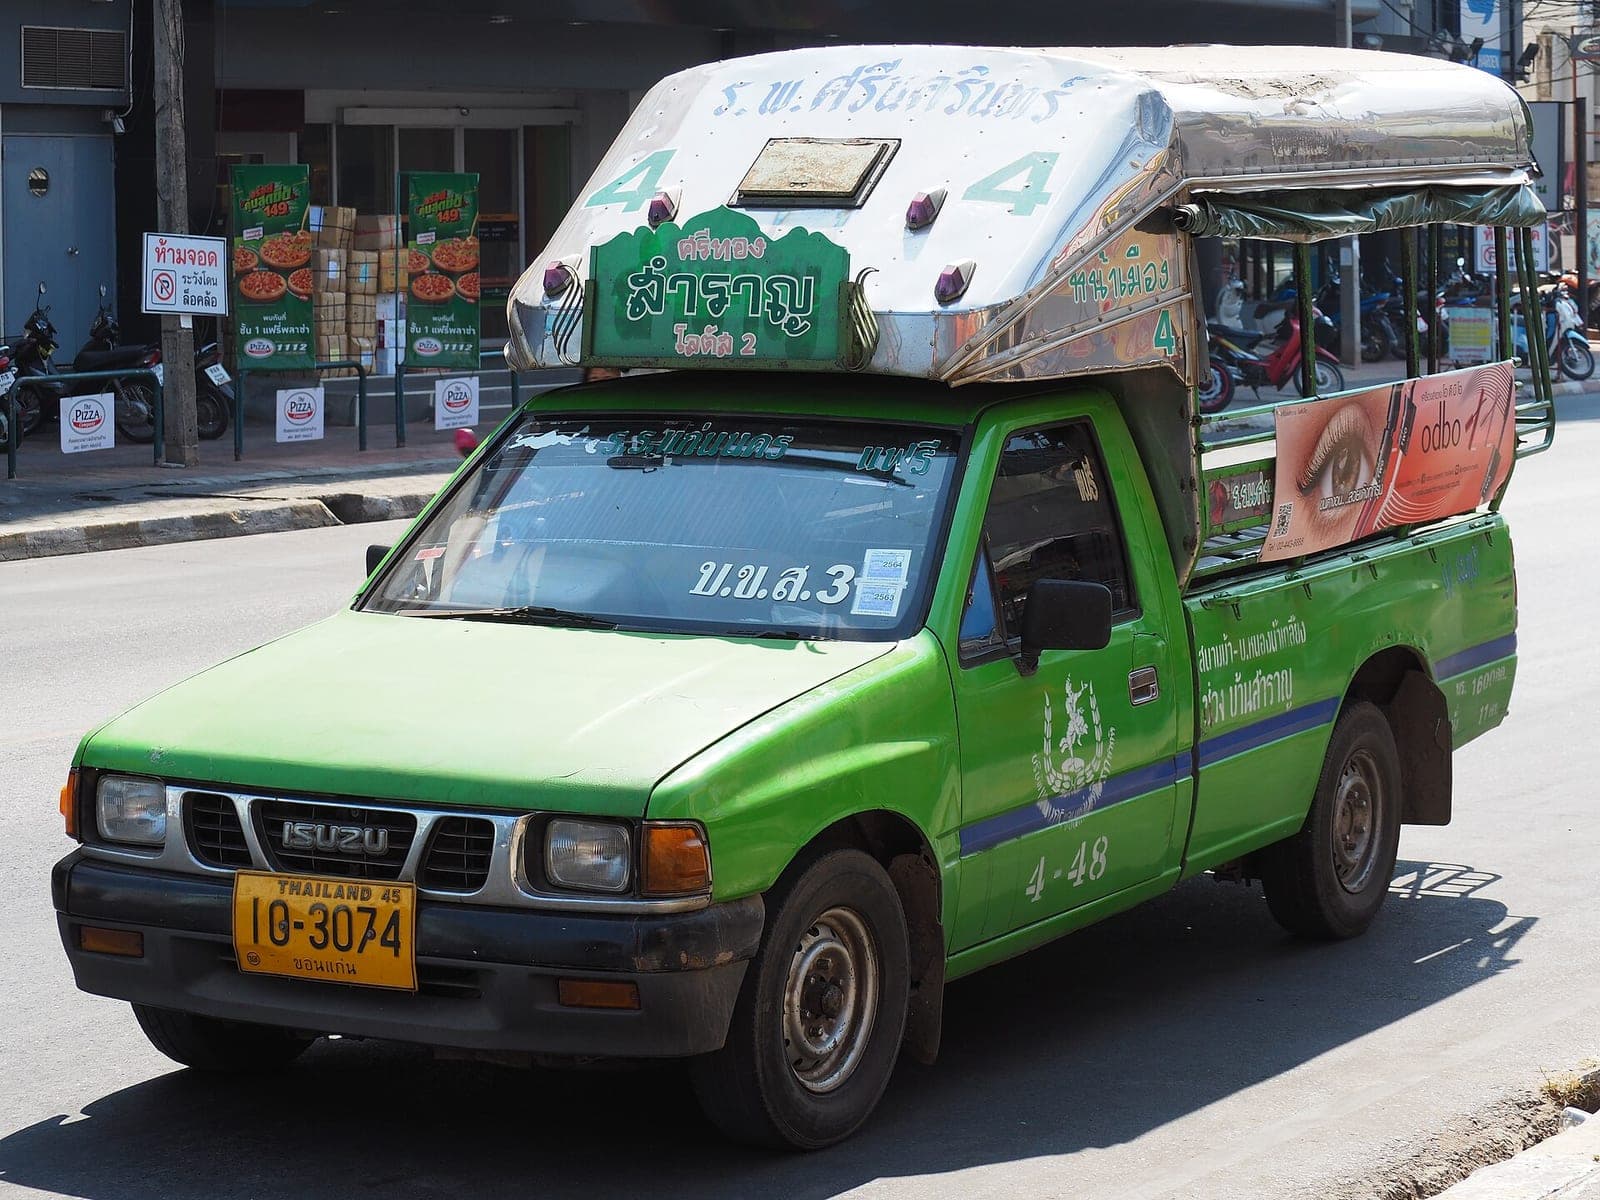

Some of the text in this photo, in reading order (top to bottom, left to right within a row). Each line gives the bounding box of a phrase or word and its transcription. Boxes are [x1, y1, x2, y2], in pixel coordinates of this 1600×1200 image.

[584, 149, 678, 213] 4
[962, 152, 1060, 216] 4
[264, 202, 289, 217] 149
[438, 209, 460, 223] 149
[154, 238, 218, 267] ห้ามจอด
[677, 228, 766, 261] ศรีทอง
[182, 271, 218, 287] ระวังโดน
[627, 256, 814, 337] สำราญ
[240, 323, 252, 335] ชั้น
[255, 326, 260, 335] 1
[423, 326, 429, 334] 1
[674, 324, 758, 357] โลตัส 2
[1153, 308, 1175, 356] 4
[277, 343, 308, 352] 1112
[444, 343, 473, 352] 1112
[75, 409, 100, 421] PIZZA
[1421, 400, 1461, 454] odbo
[689, 561, 856, 604] บ.ข.ส.3
[873, 593, 895, 601] 2563
[282, 821, 388, 855] ISUZU
[1026, 835, 1109, 903] 4-48
[278, 879, 401, 904] THAILAND 45
[253, 897, 401, 958] 10-3074
[293, 957, 357, 975] ขอนแก่น
